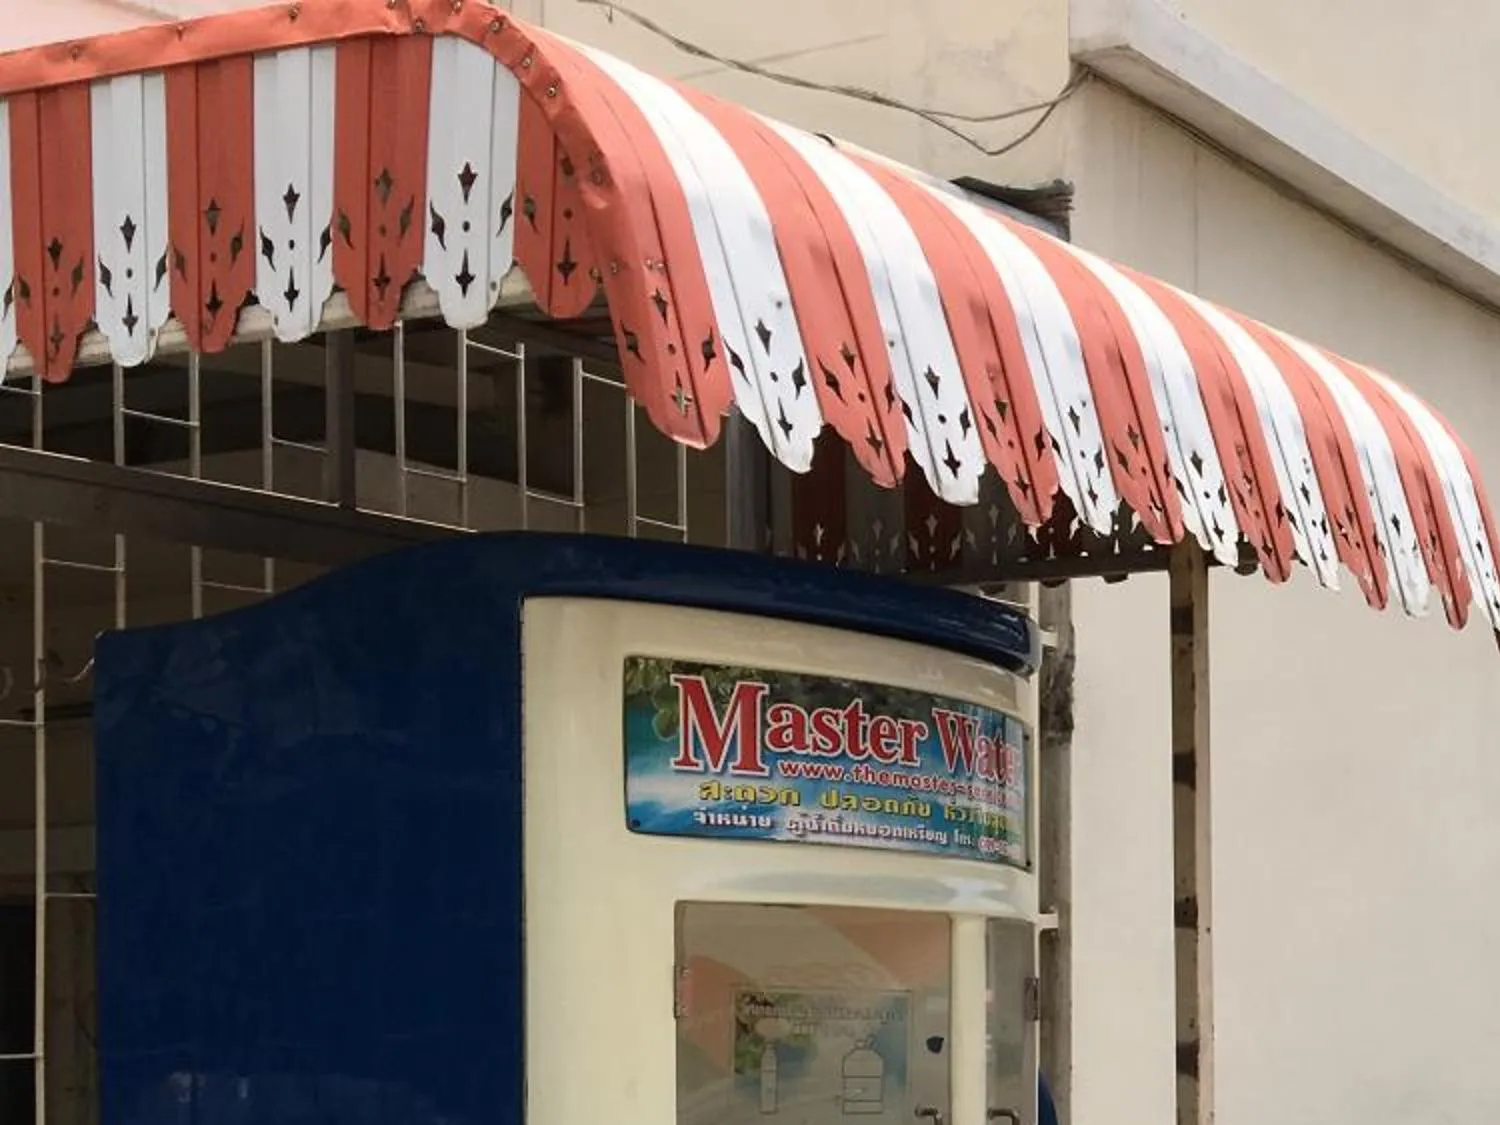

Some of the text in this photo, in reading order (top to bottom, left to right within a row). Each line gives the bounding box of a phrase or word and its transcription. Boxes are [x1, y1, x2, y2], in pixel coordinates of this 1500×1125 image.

[671, 673, 928, 778] Master
[699, 779, 801, 806] สะดวก
[820, 785, 931, 818] ปลอดภัย
